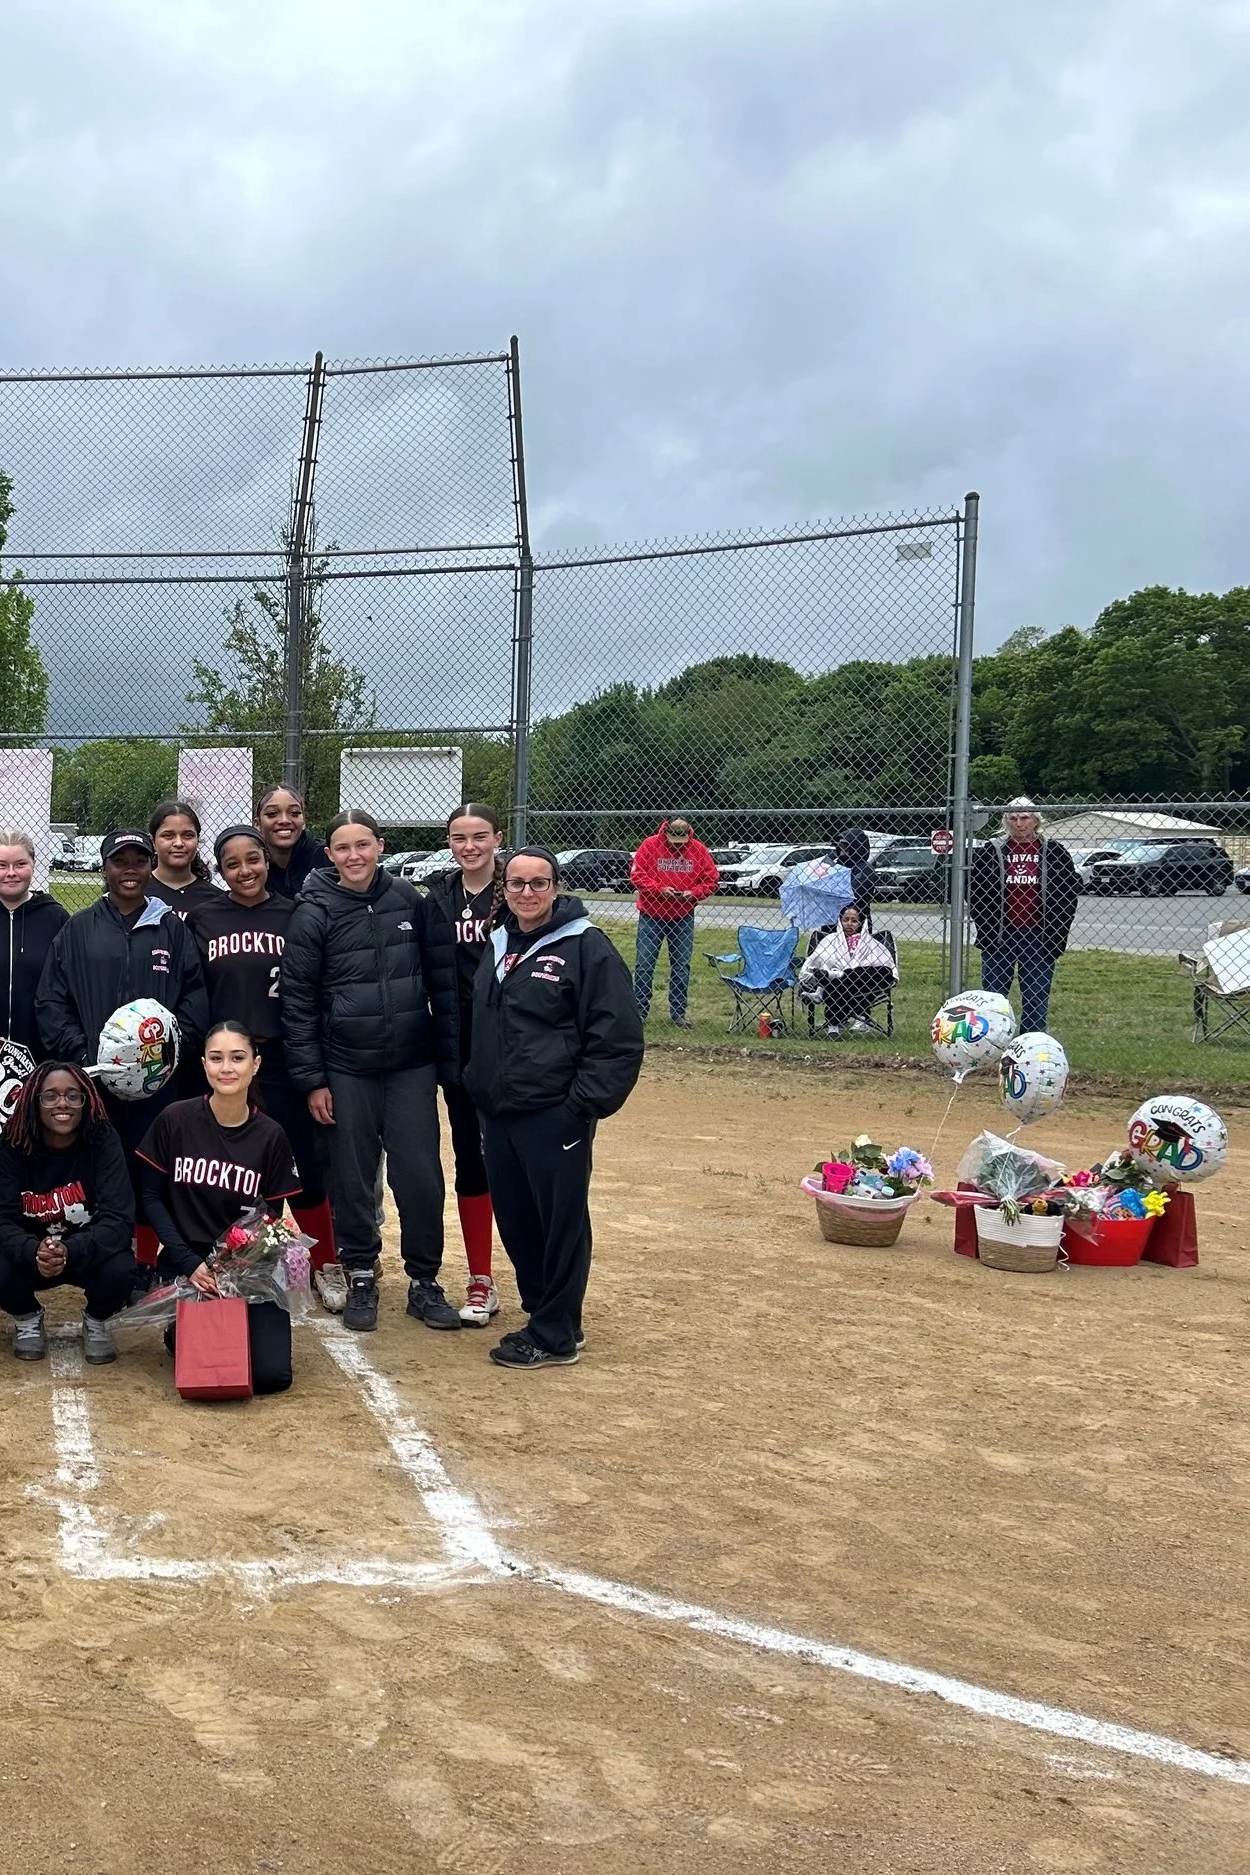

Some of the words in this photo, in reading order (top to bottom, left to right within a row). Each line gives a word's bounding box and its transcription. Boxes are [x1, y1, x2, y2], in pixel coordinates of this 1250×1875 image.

[455, 920, 496, 943] CK
[268, 966, 280, 998] 2
[943, 993, 988, 1008] CNRATS
[3, 1043, 36, 1074] CONGRATS
[1150, 1104, 1206, 1134] CONGRATS
[1129, 1120, 1203, 1171] GRAD
